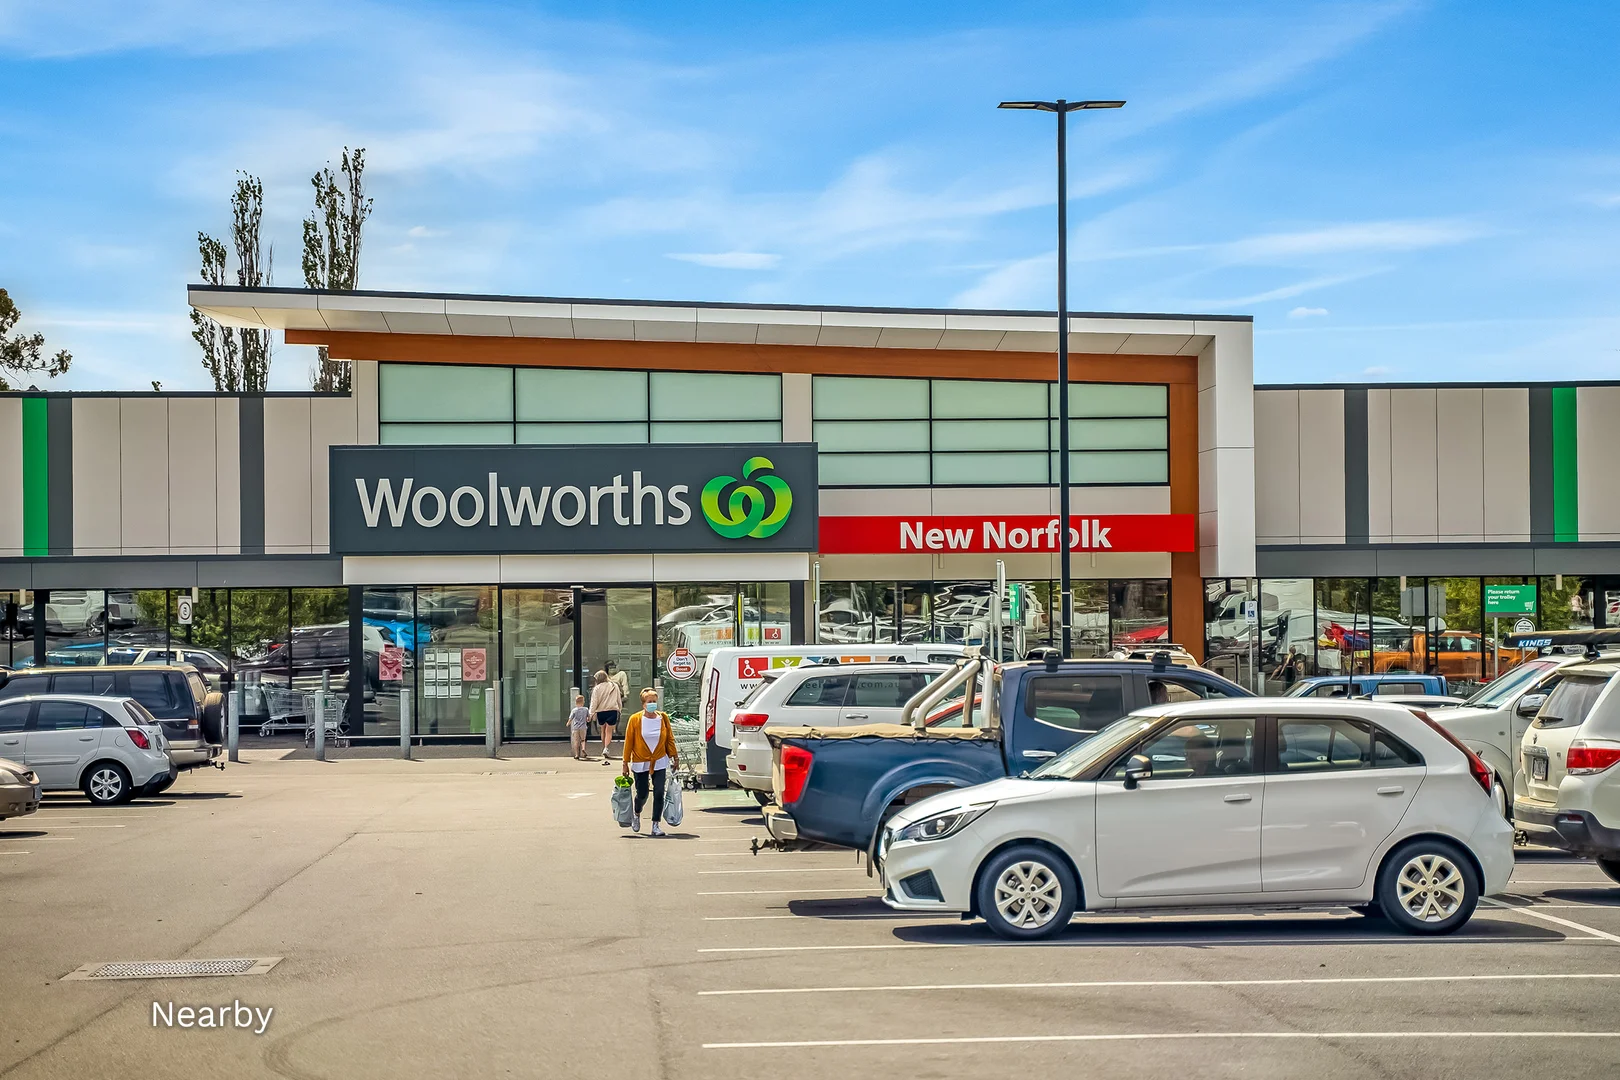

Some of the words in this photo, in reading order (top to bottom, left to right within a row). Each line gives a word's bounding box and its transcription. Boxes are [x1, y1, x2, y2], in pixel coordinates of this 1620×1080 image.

[354, 470, 692, 528] Woolworths
[900, 521, 974, 549] New
[983, 519, 1113, 549] Norfolk
[1518, 638, 1552, 648] KINGS
